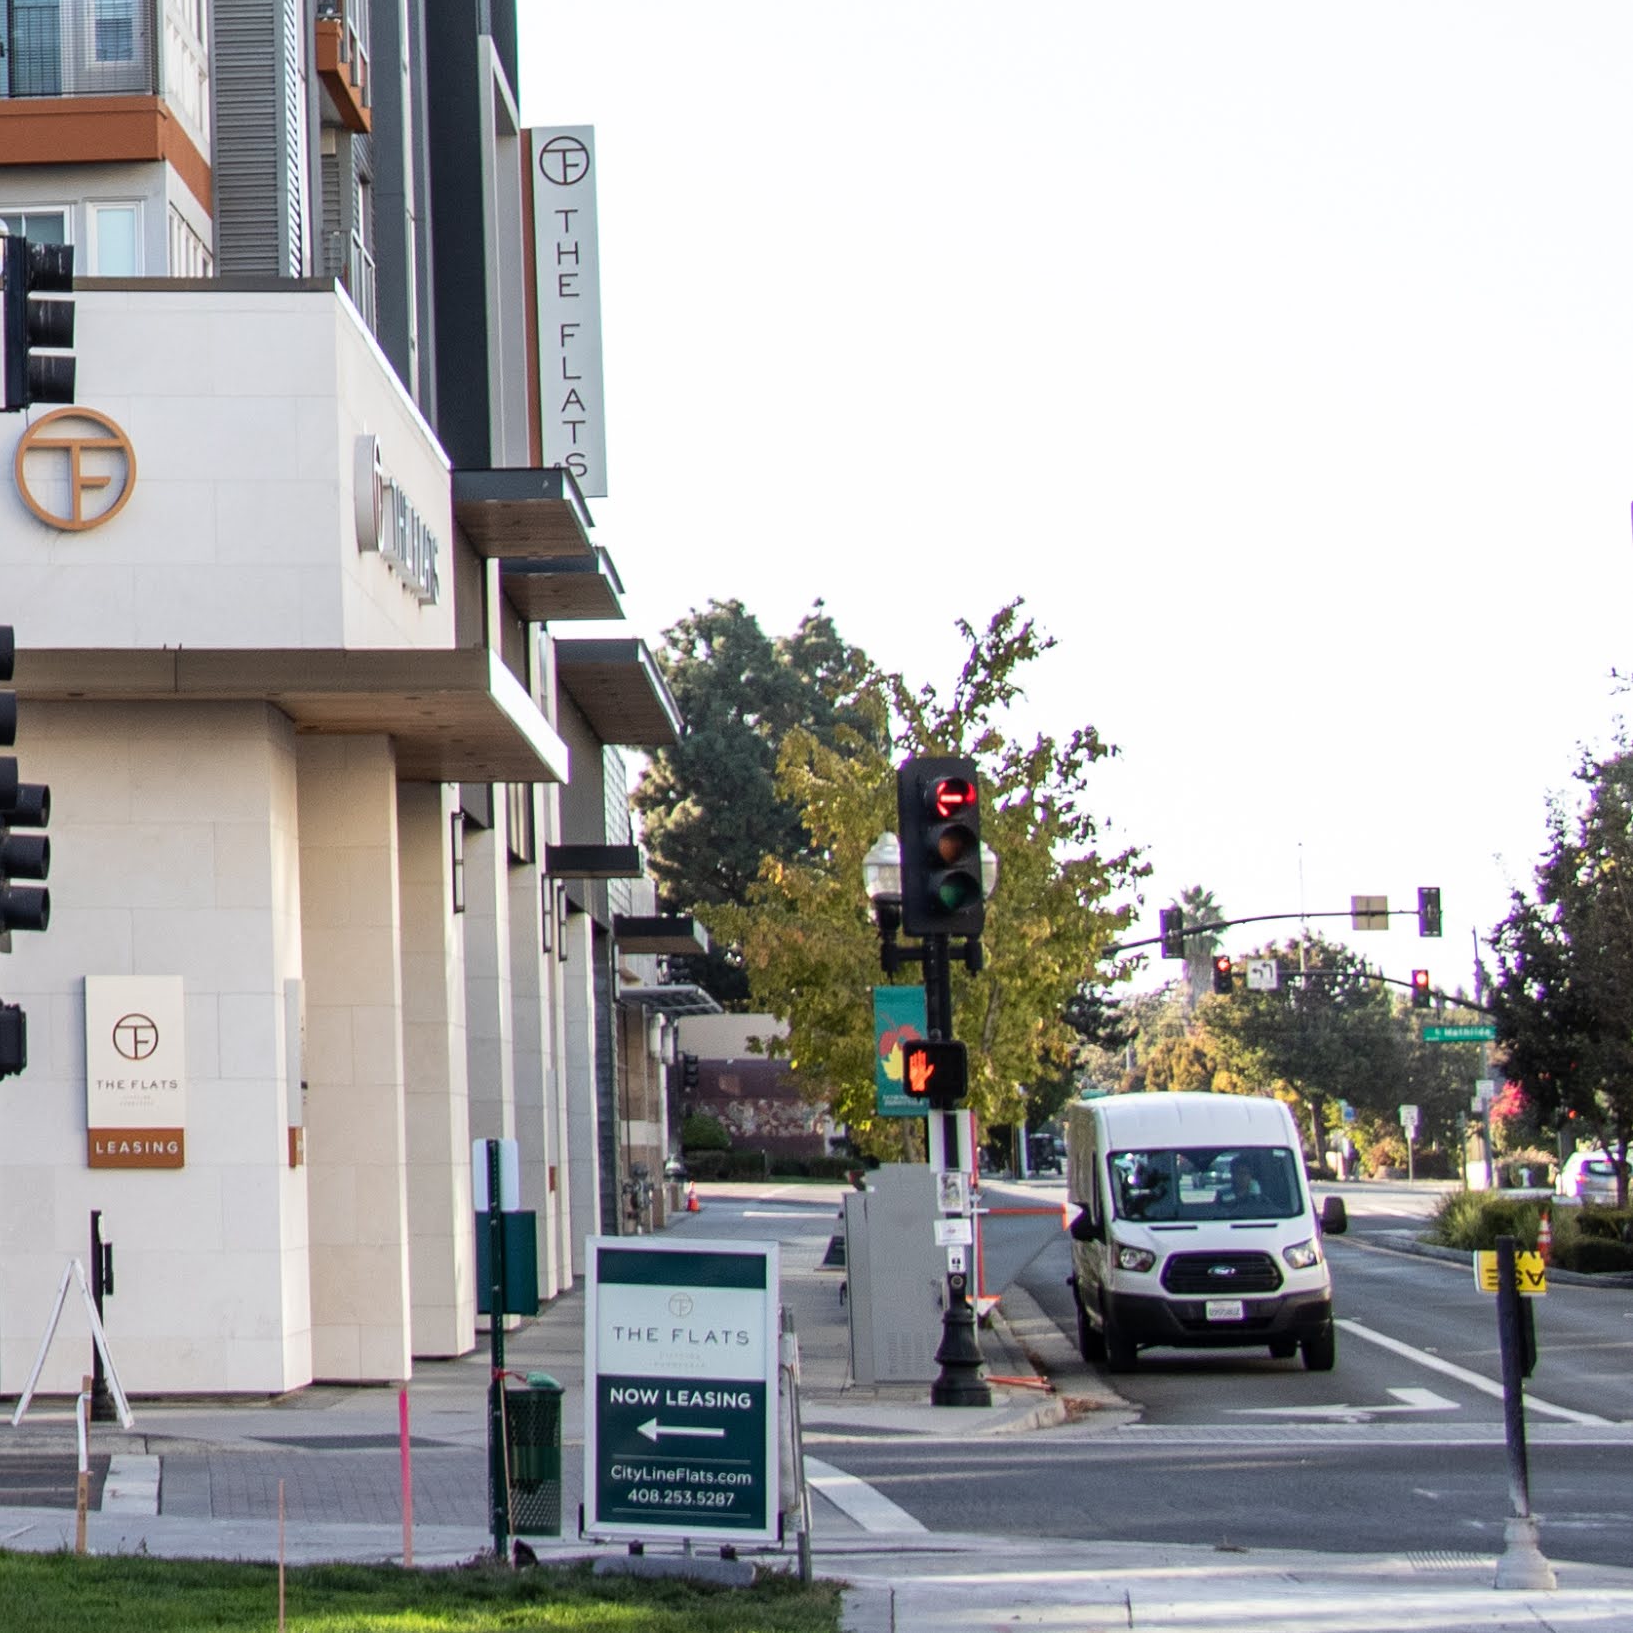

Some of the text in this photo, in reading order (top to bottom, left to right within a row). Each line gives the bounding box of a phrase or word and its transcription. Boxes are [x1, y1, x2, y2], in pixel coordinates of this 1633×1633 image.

[554, 209, 581, 297] THE
[560, 323, 588, 478] FLATS
[97, 1080, 178, 1089] THE FLATS
[96, 1141, 179, 1154] LEASING
[613, 1326, 750, 1346] THE FLATS
[610, 1387, 751, 1409] NOW LEASING
[611, 1465, 752, 1485] CityLineFlats.com
[628, 1488, 735, 1507] 408.253.5287
